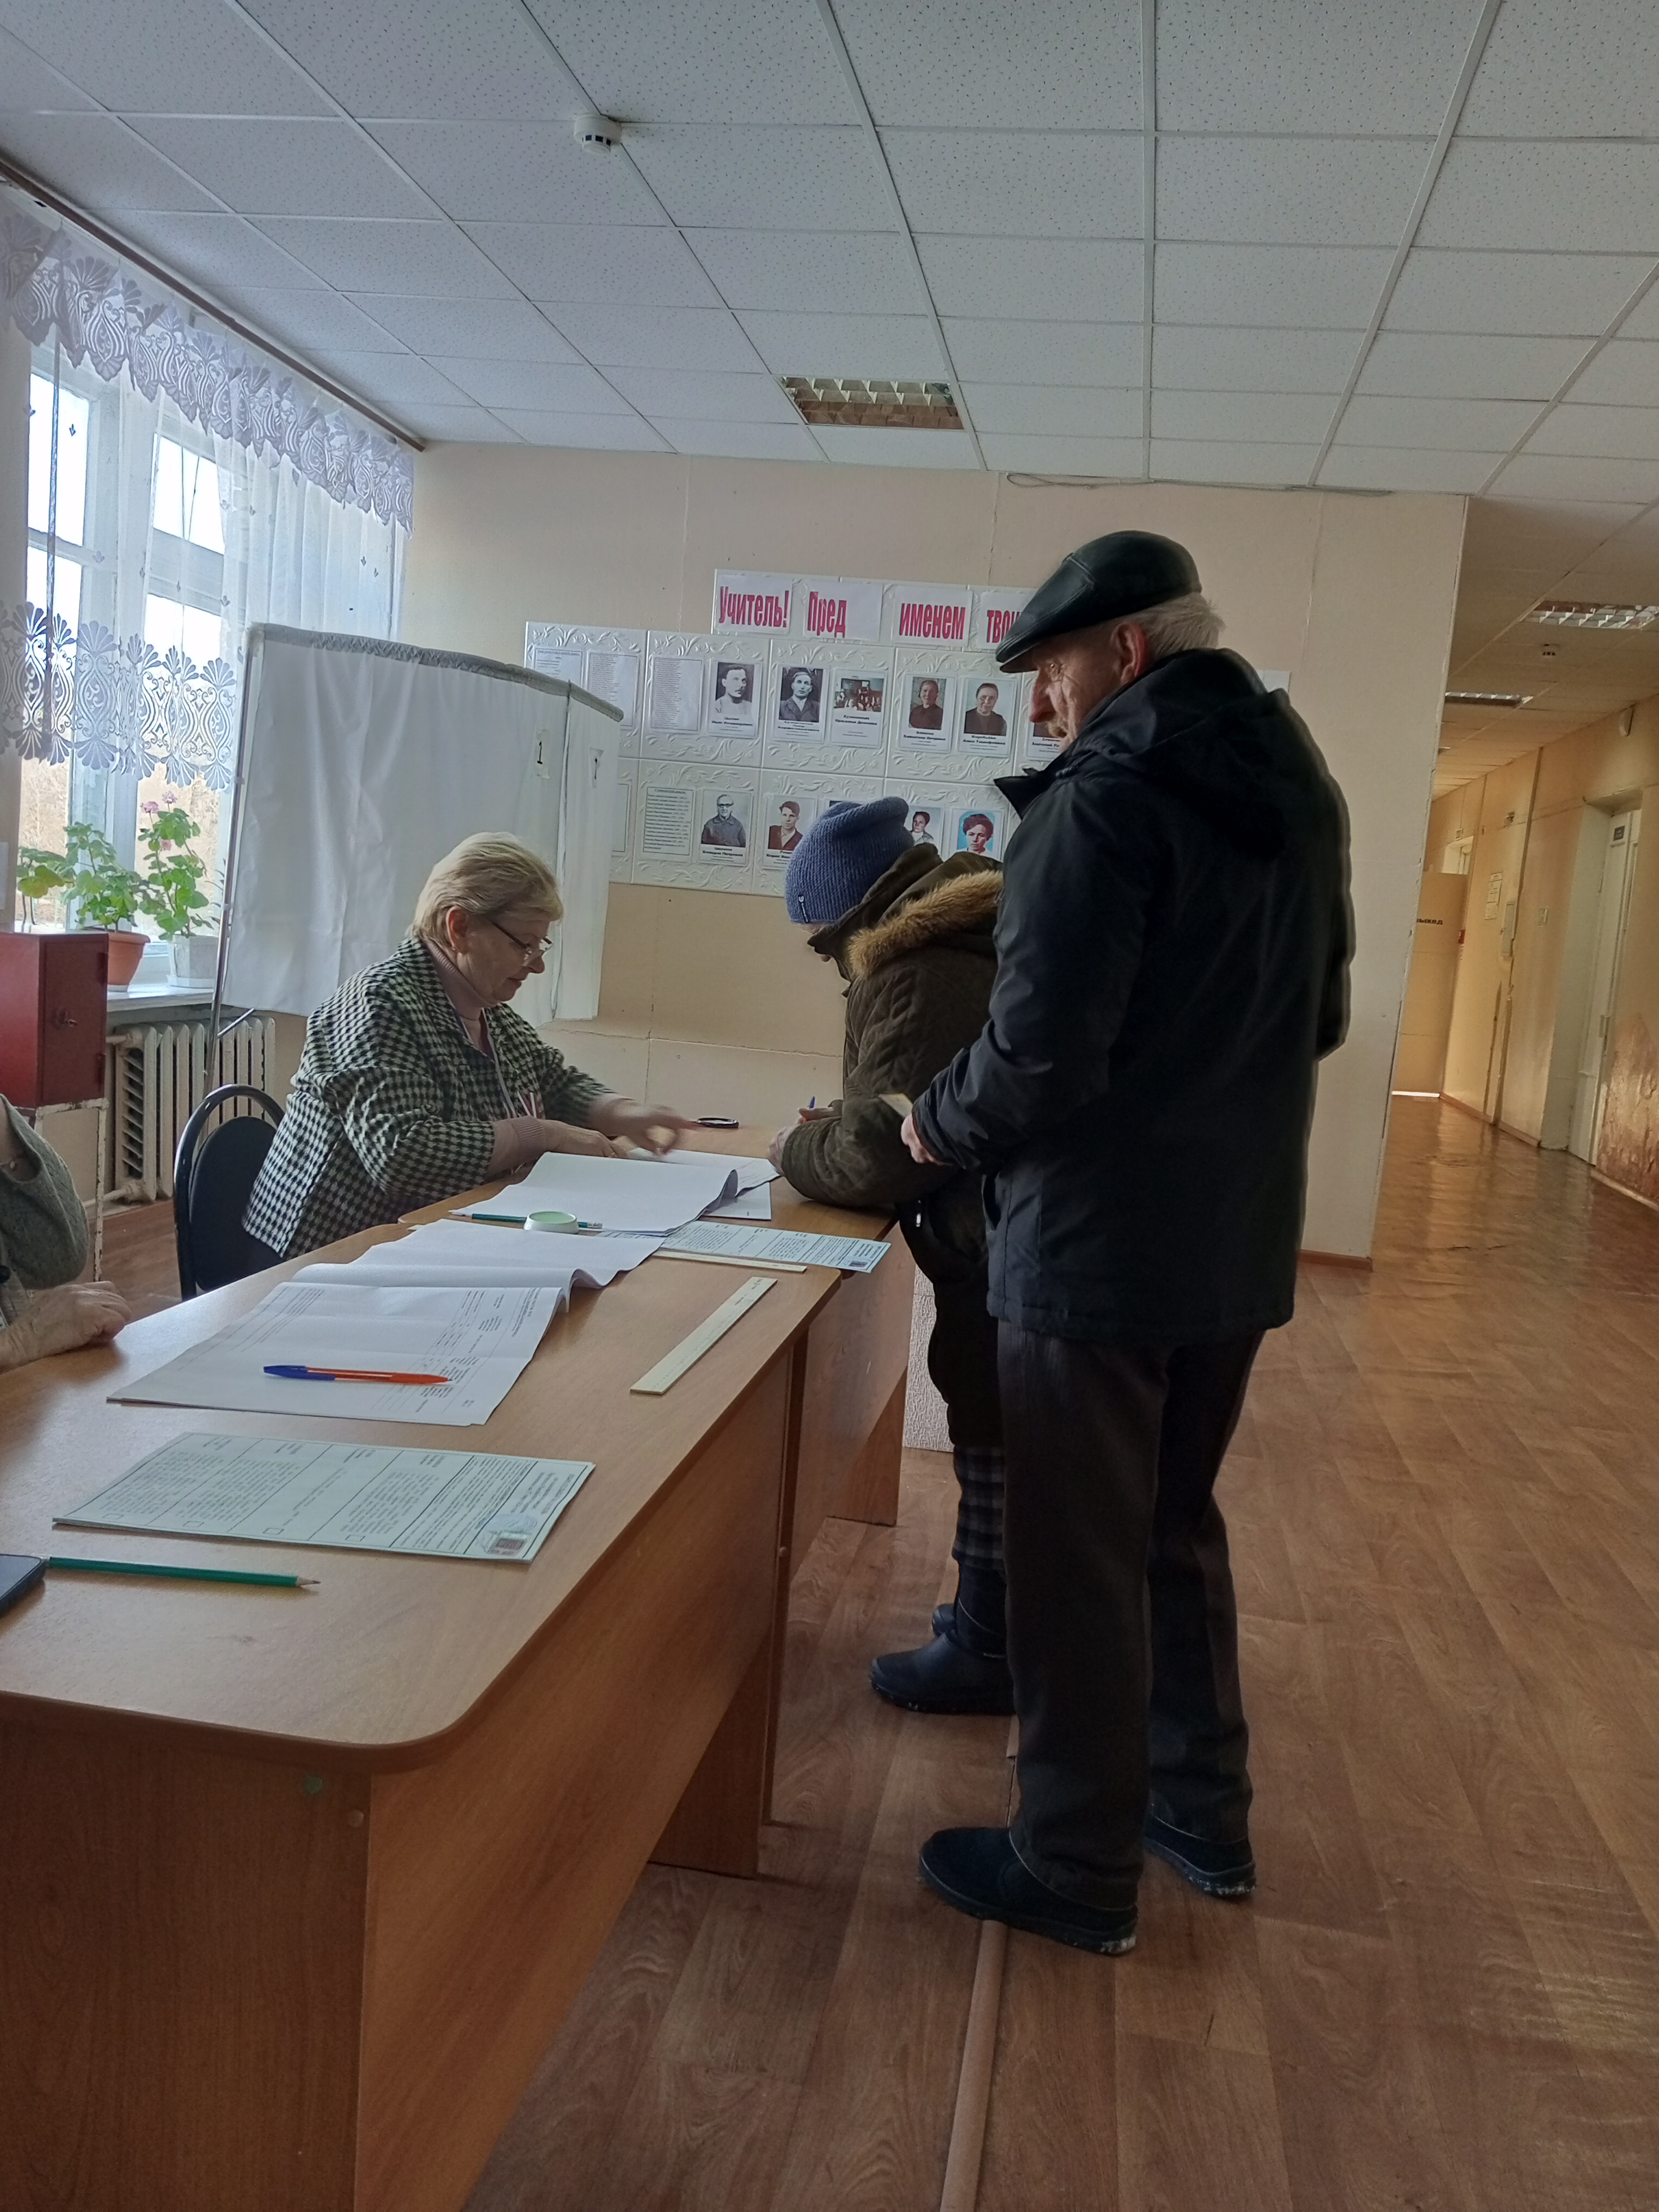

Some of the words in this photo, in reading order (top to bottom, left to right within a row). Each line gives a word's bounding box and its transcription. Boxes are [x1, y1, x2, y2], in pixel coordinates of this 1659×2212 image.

[719, 586, 789, 628] Учитель!
[807, 591, 847, 638] Пред
[899, 603, 966, 640] именем
